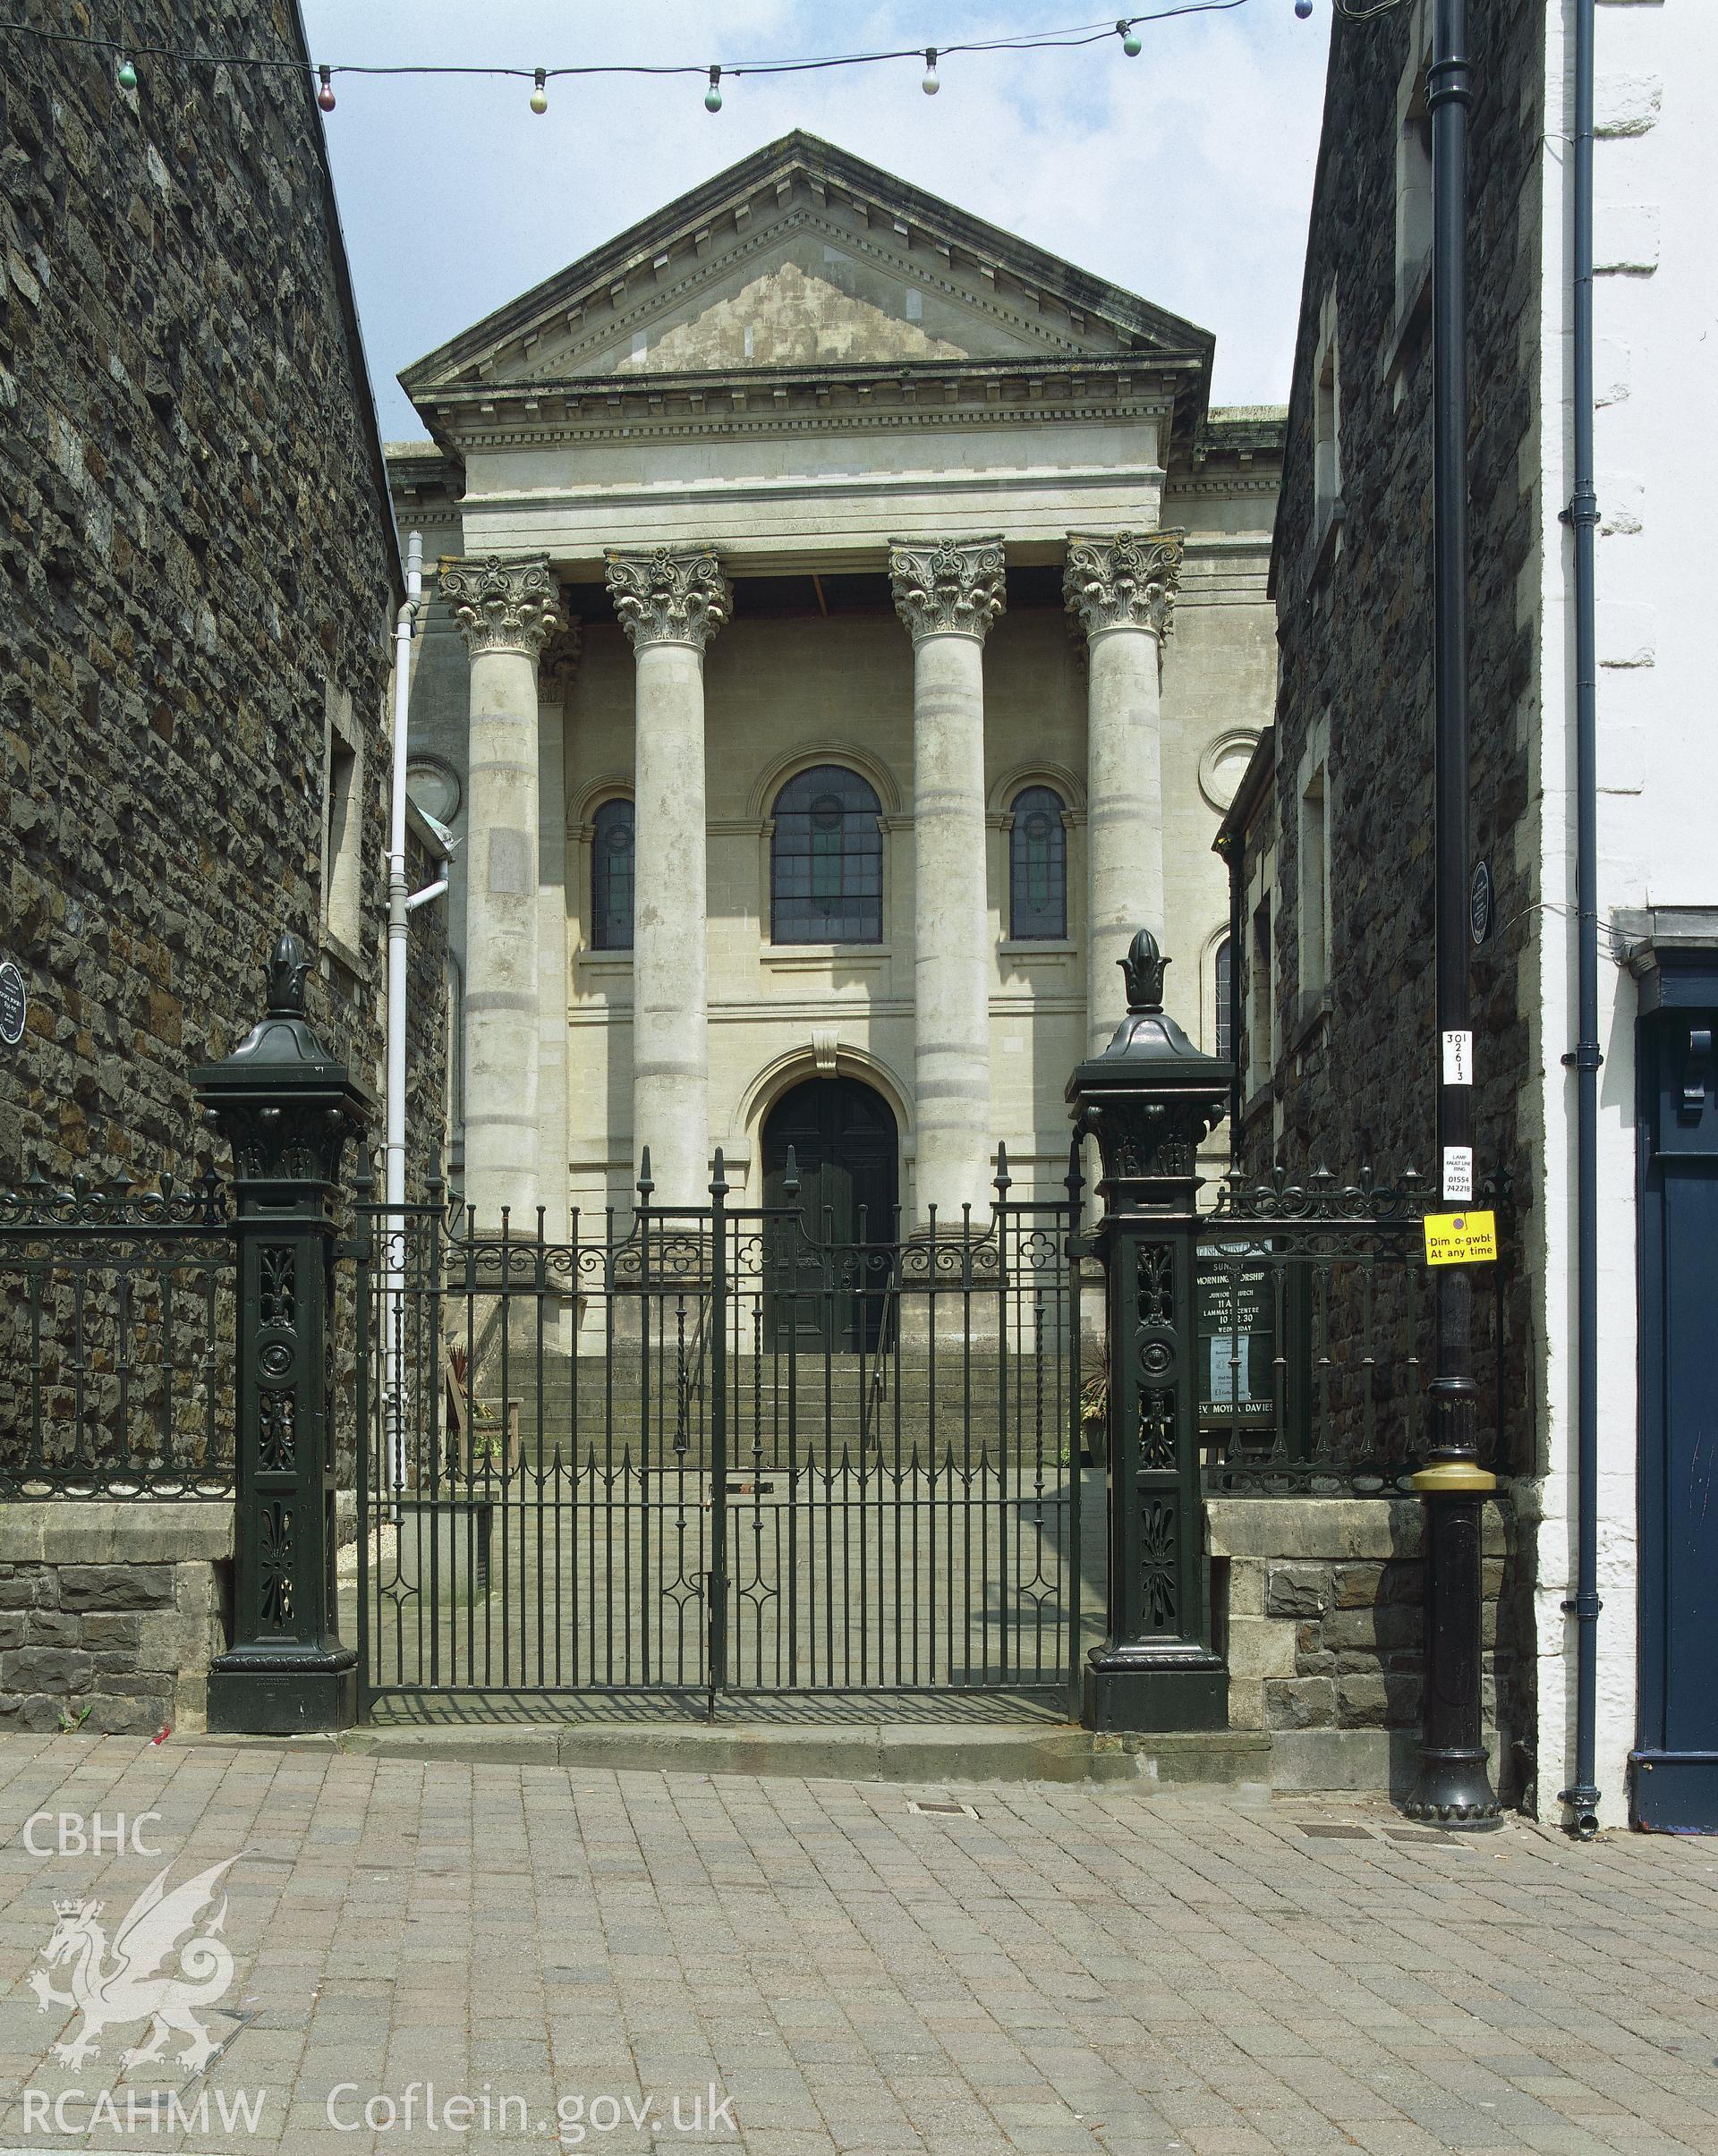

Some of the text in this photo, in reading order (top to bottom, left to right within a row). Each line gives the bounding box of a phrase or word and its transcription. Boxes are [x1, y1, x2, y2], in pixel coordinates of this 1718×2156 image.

[1448, 1176, 1469, 1184] 01554
[1446, 1184, 1470, 1193] 742218
[1430, 1237, 1450, 1246] Dim
[1431, 1246, 1493, 1259] At any time
[1203, 1309, 1229, 1317] LAMMAS
